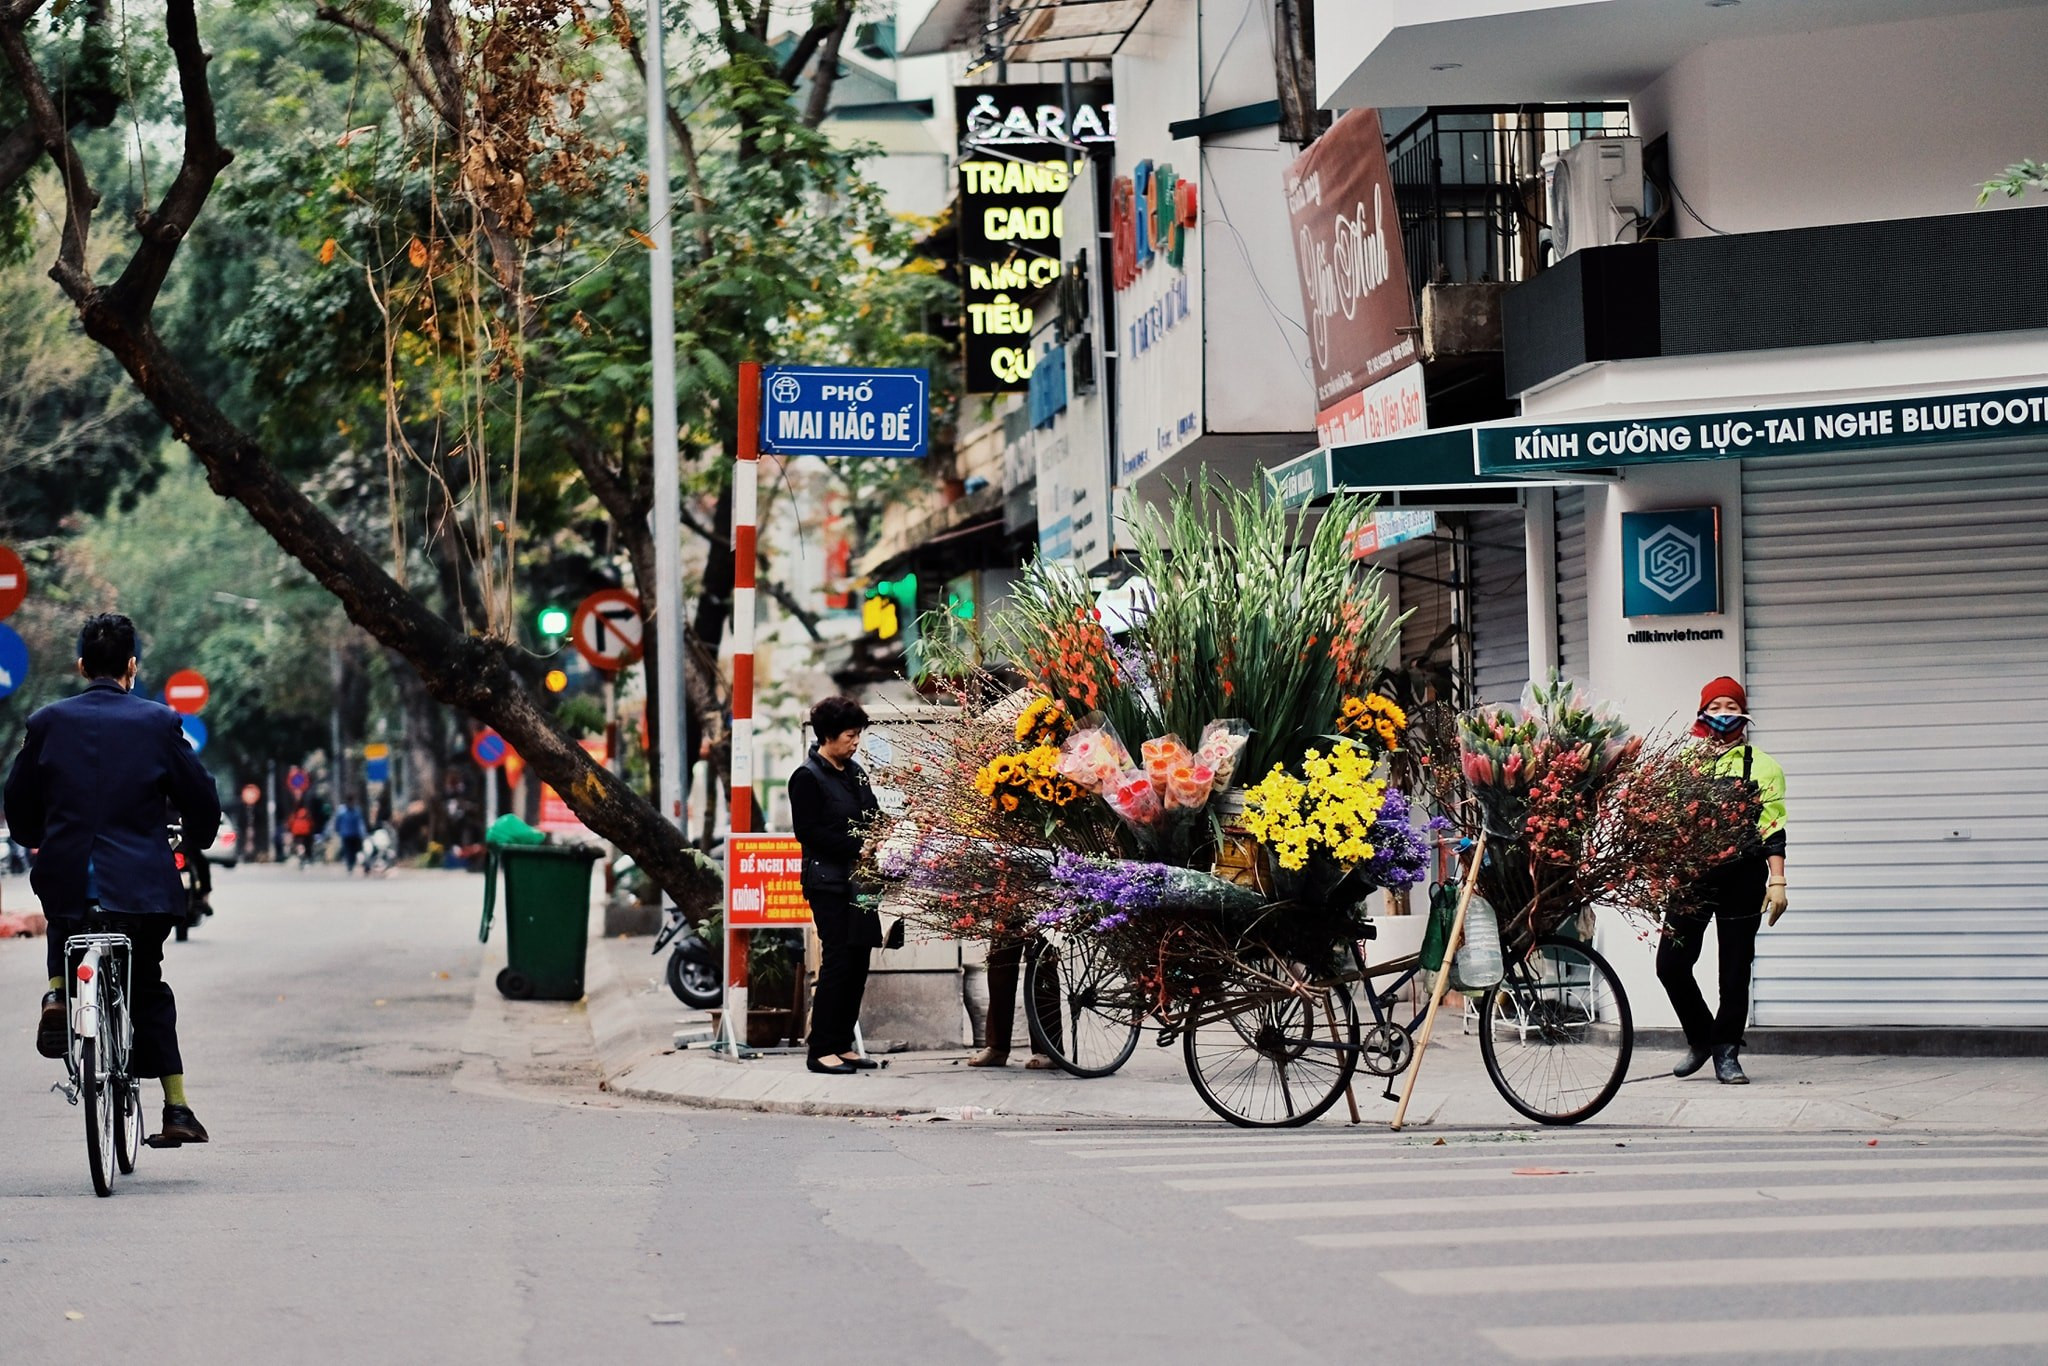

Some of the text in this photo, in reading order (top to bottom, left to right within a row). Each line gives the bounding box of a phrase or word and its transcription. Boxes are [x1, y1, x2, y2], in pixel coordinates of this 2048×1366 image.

[960, 160, 1069, 194] TRANG
[984, 207, 1050, 240] CAO
[821, 379, 874, 402] PHỐ
[778, 402, 913, 441] MAI HẮC ĐẾ
[1514, 428, 1579, 460] KÍNH
[1586, 423, 1692, 456] CƯỜNG
[1813, 410, 1894, 440] NGHE
[1627, 628, 1724, 644] nillkinvietnam
[757, 859, 785, 876] NGHỊ
[786, 858, 802, 873] NH
[732, 883, 761, 912] KHÔNG
